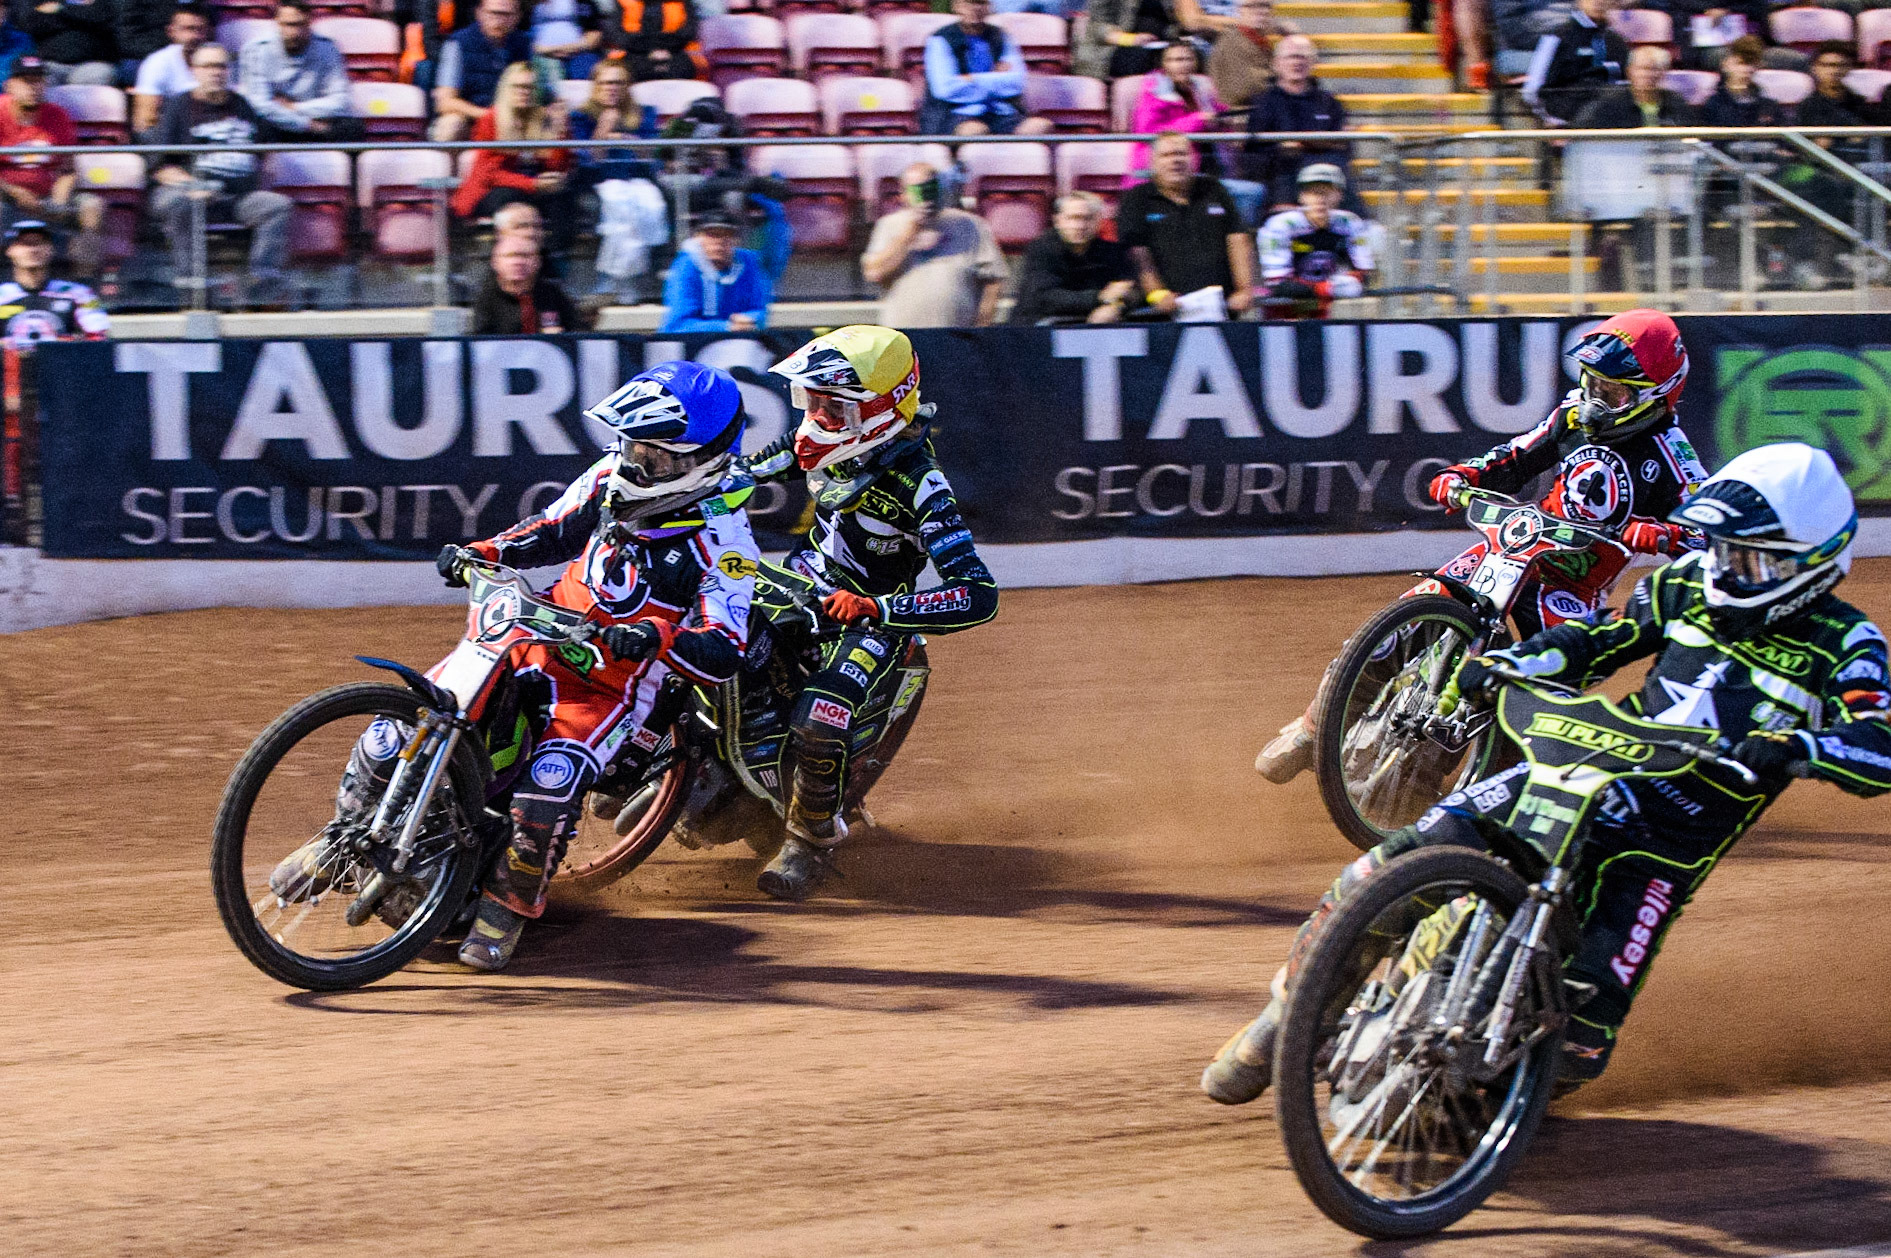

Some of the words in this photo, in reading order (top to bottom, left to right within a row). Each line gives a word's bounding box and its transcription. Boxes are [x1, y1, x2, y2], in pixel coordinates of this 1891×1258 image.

[1051, 320, 1606, 441] TAURU
[1051, 458, 1390, 520] SECURITY
[1568, 449, 1598, 466] BELLE
[1616, 473, 1628, 502] ACES
[121, 484, 499, 545] SECURITY
[635, 729, 658, 747] NGK
[814, 701, 849, 722] NGK
